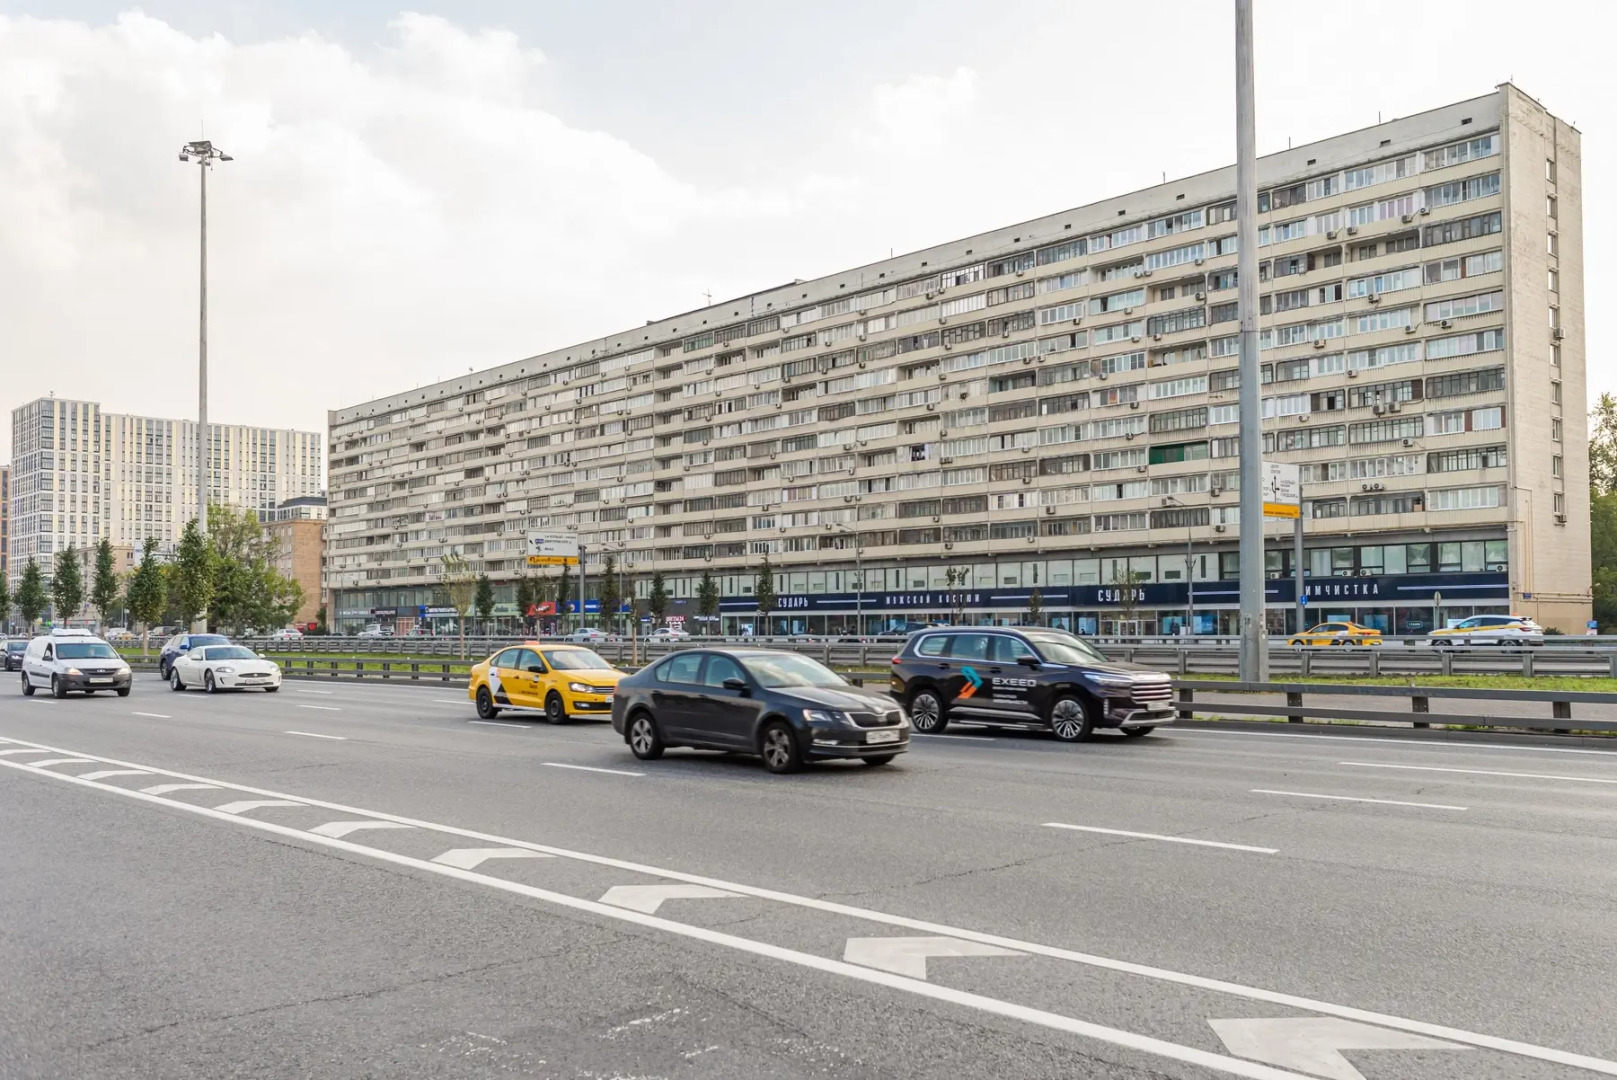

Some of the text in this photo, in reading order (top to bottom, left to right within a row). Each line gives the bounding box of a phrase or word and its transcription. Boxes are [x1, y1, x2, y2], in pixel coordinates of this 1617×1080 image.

[1097, 588, 1145, 602] СУДАРЬ
[1304, 584, 1379, 596] ИМЧИСТКА
[777, 597, 809, 608] СУДАРЬ
[938, 593, 980, 604] КОСТЮМ
[992, 677, 1037, 687] EXEED
